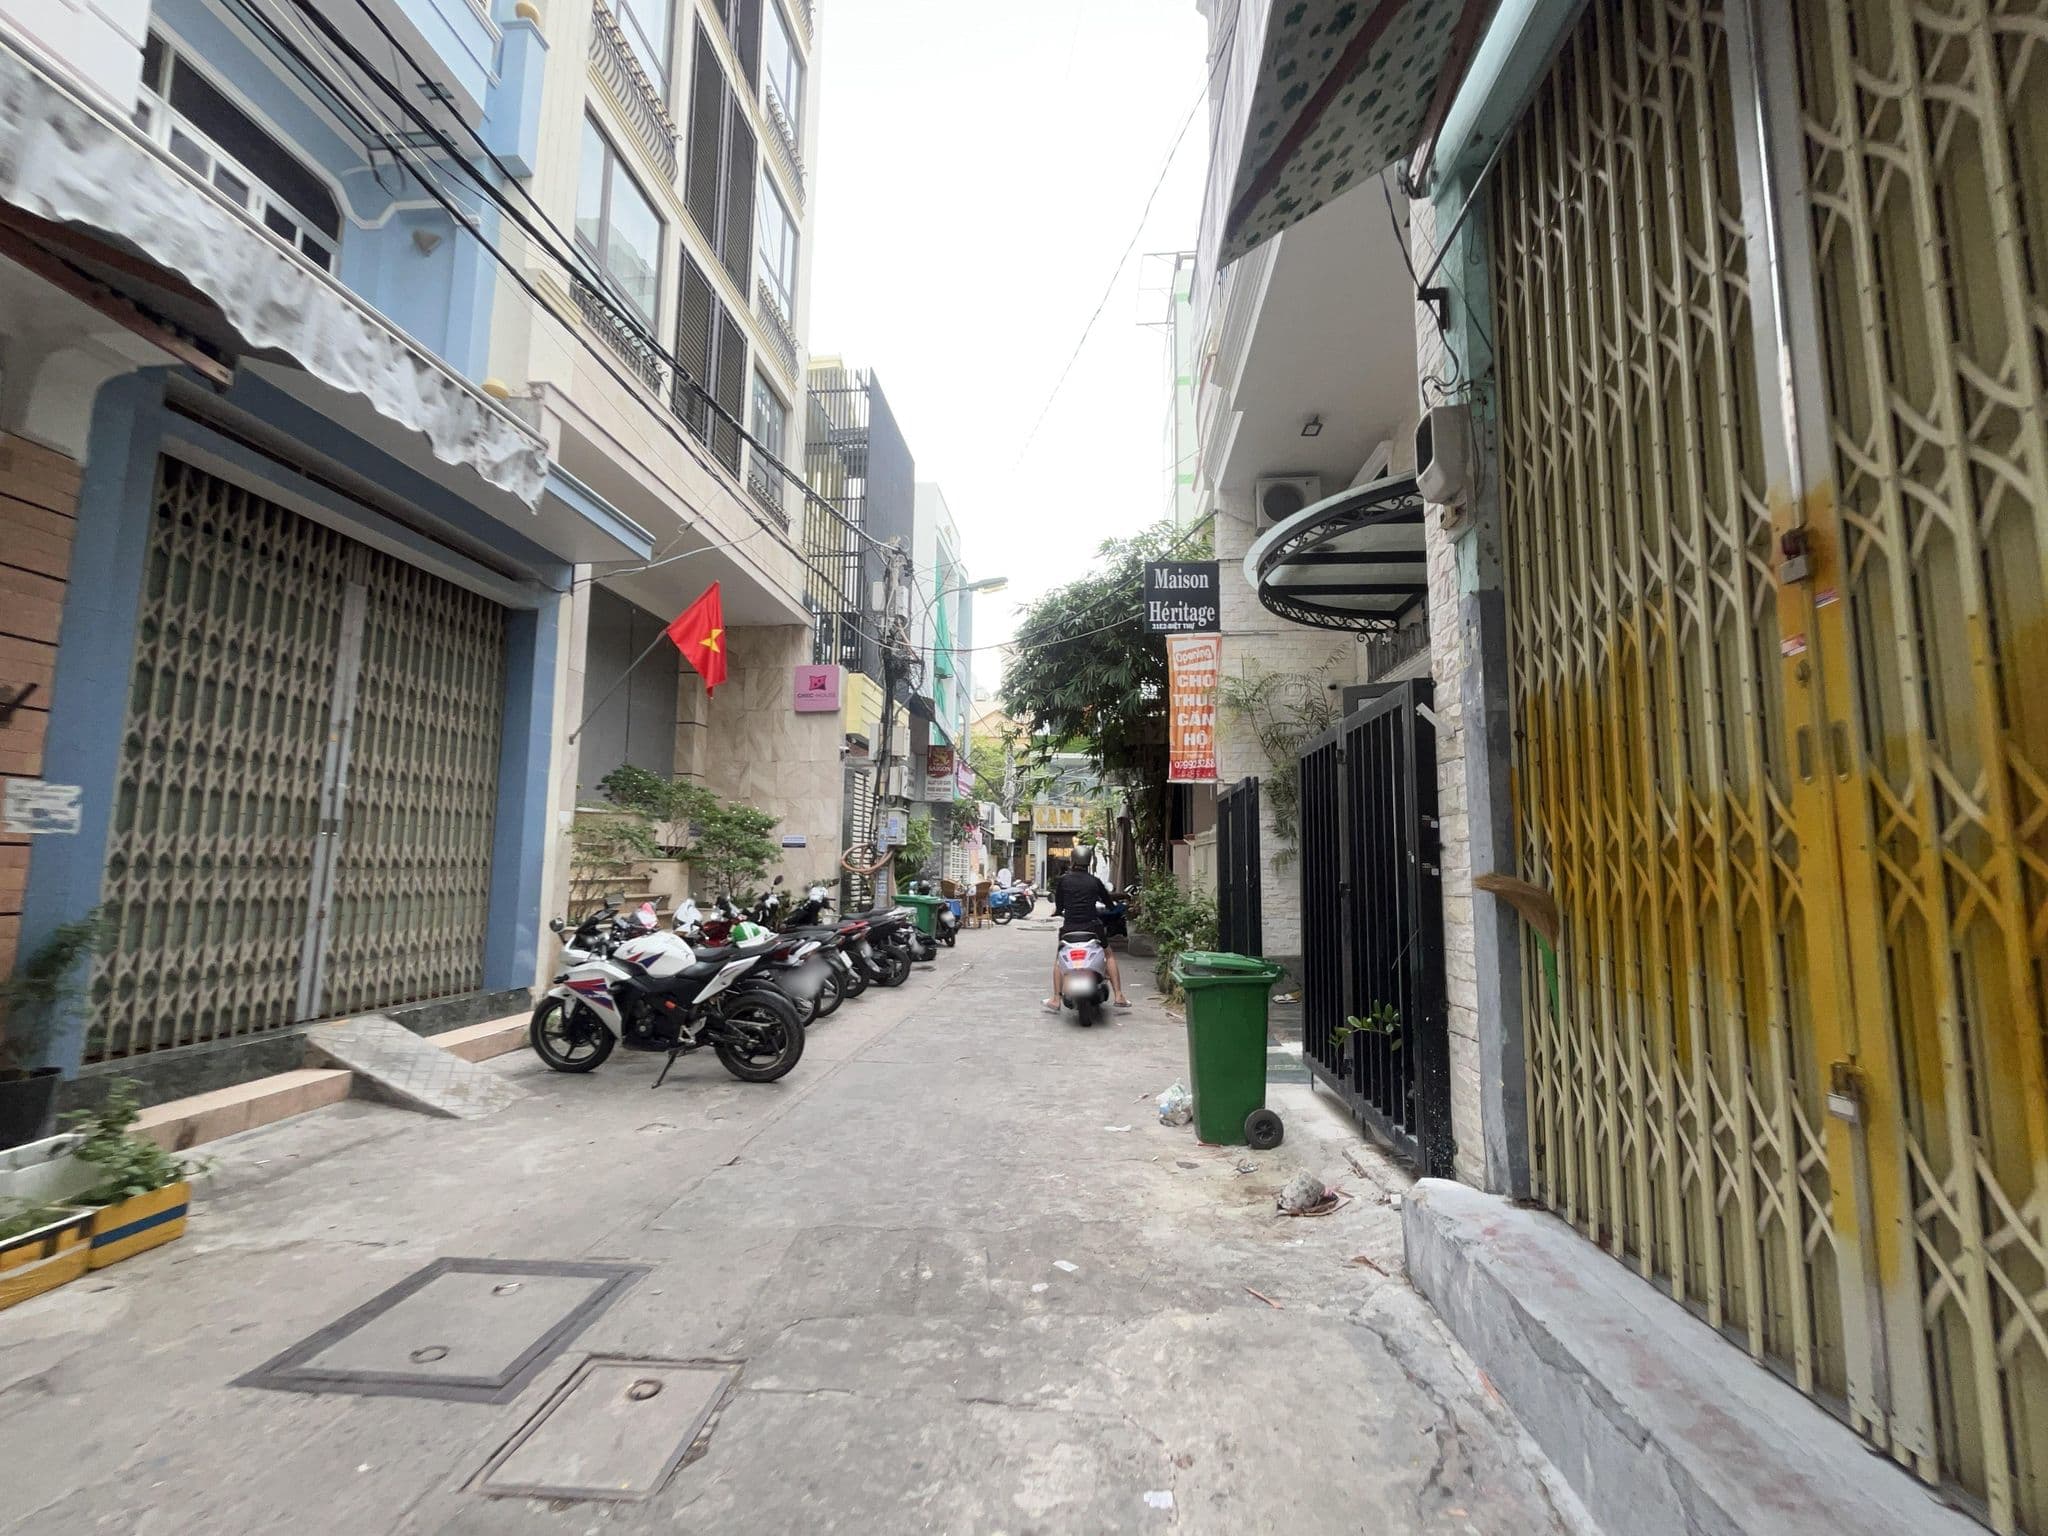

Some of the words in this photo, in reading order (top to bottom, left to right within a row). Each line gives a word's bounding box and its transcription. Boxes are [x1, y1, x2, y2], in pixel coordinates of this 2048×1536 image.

[1154, 568, 1209, 589] Maison
[1149, 600, 1216, 627] Héritage
[1177, 674, 1214, 688] CHO
[1183, 729, 1208, 749] HỘ
